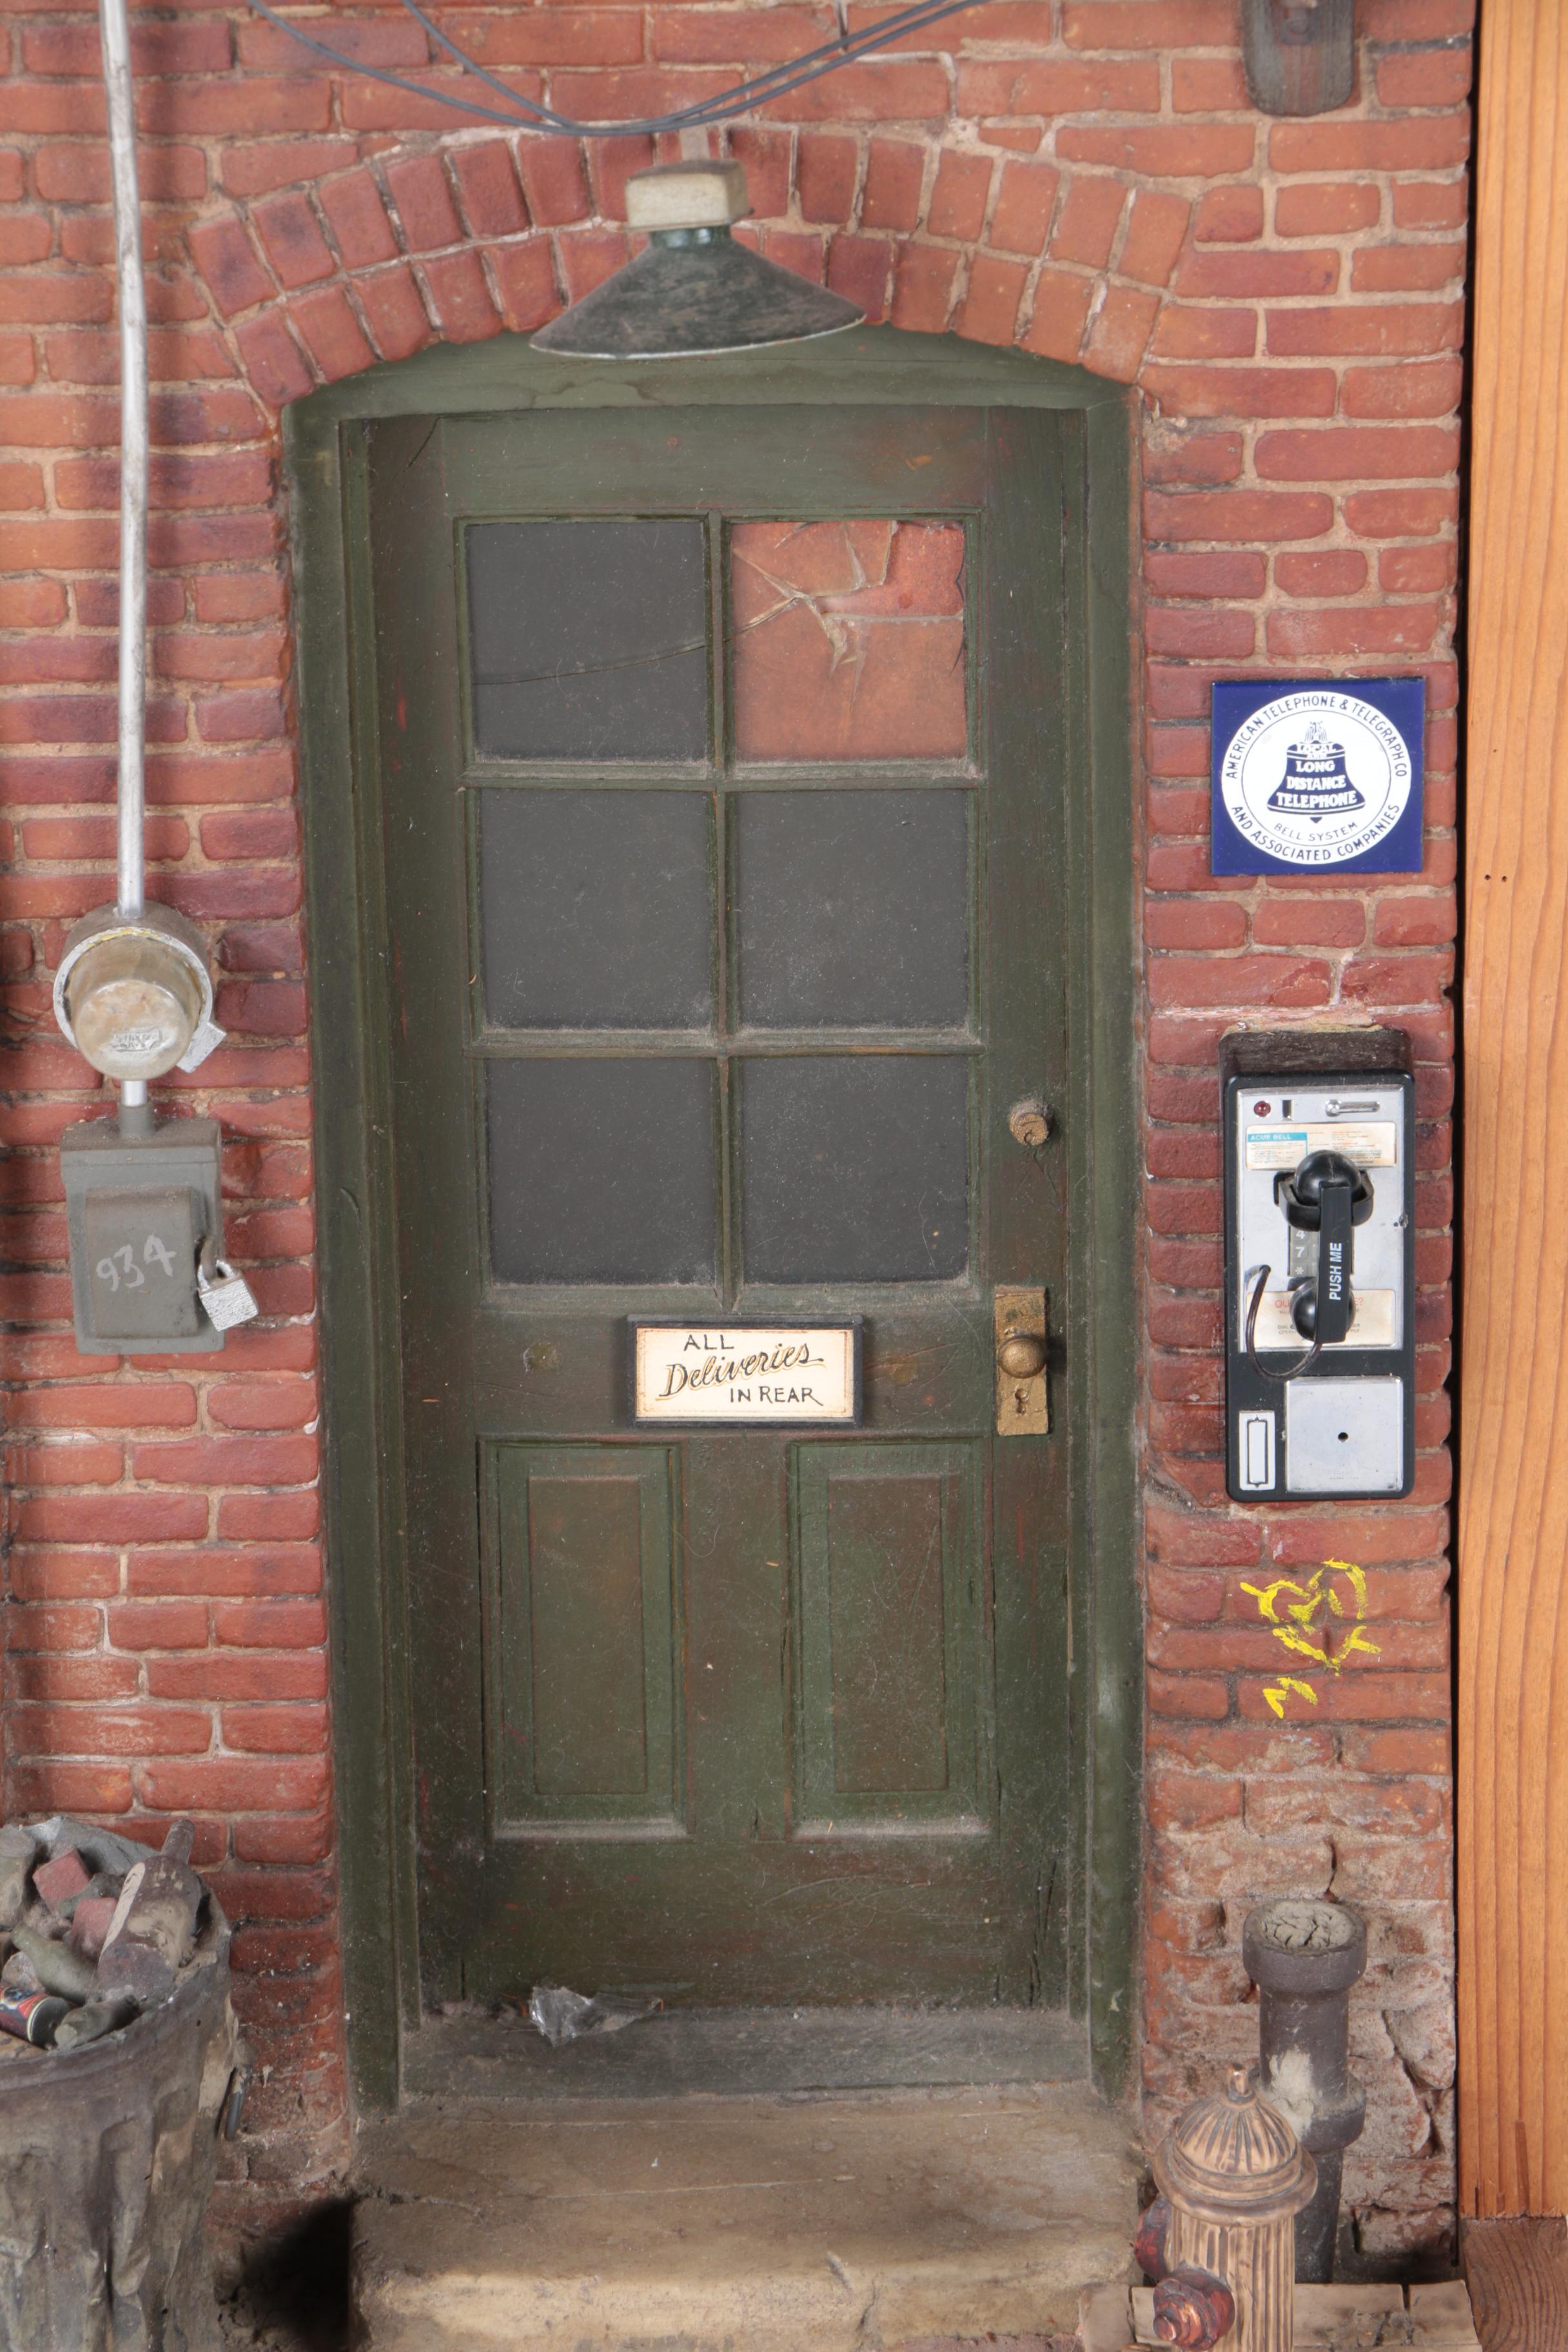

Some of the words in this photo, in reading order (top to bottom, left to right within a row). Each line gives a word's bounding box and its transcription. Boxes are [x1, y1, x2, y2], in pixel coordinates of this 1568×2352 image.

[1226, 718, 1263, 779] AMERICAN
[1263, 695, 1336, 720] TELEPHONE
[1339, 699, 1348, 709] &
[1353, 703, 1405, 760] TELEGRAPH
[1296, 743, 1337, 753] LOCAL
[1295, 760, 1335, 772] LONG
[1286, 774, 1346, 790] DISTANCE
[1276, 790, 1357, 808] TELEPHONE
[1231, 806, 1253, 830] AND
[1251, 830, 1331, 861] ASSOCIATED
[1337, 804, 1400, 857] COMPANIES
[1274, 823, 1302, 841] BELL
[1308, 822, 1358, 842] SYSTEM
[1295, 1230, 1306, 1239] 4
[96, 1232, 177, 1292] 934
[1295, 1246, 1305, 1258] 7
[1329, 1242, 1342, 1262] ME
[1329, 1266, 1342, 1300] PUSH
[683, 1334, 735, 1351] ALL
[657, 1342, 825, 1399] Deliveries
[730, 1387, 751, 1403] IN
[760, 1386, 823, 1406] REAR
